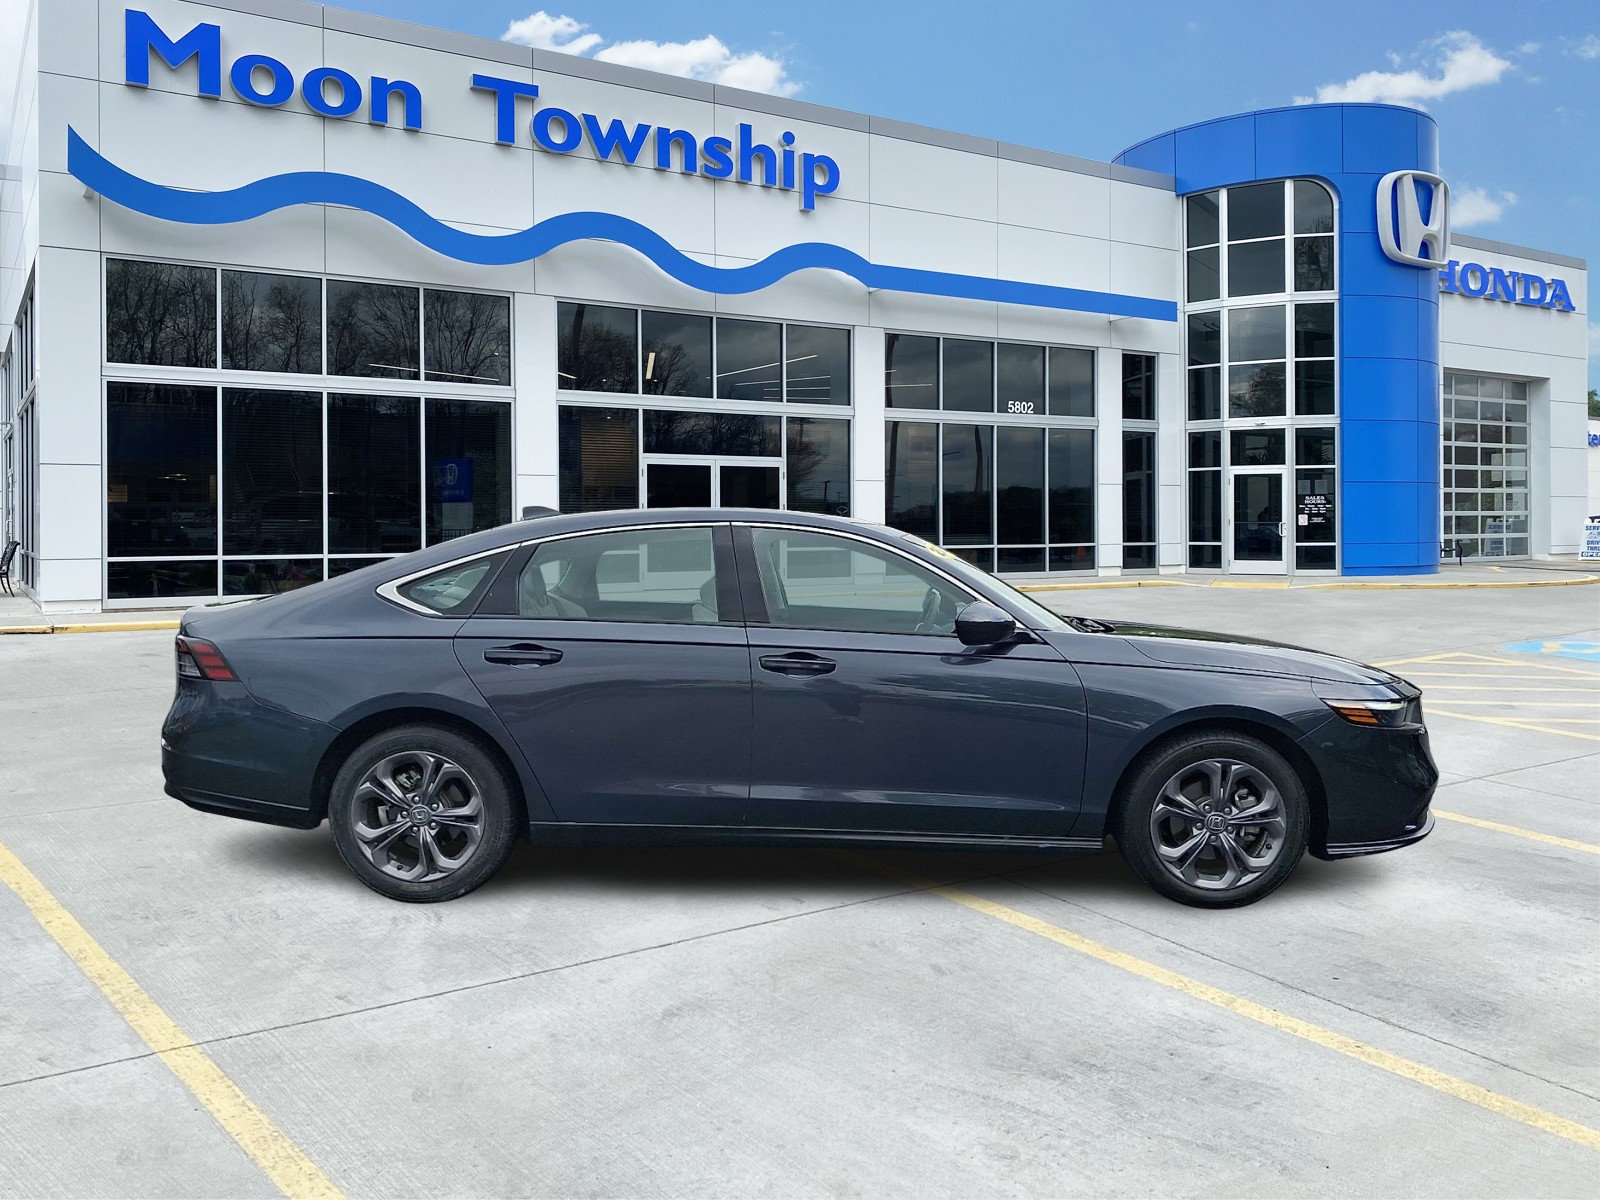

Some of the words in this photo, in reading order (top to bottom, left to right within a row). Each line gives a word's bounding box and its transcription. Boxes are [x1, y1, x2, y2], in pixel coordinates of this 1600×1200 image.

[125, 9, 422, 130] Moon
[473, 74, 841, 211] Township
[1007, 400, 1034, 414] 5802
